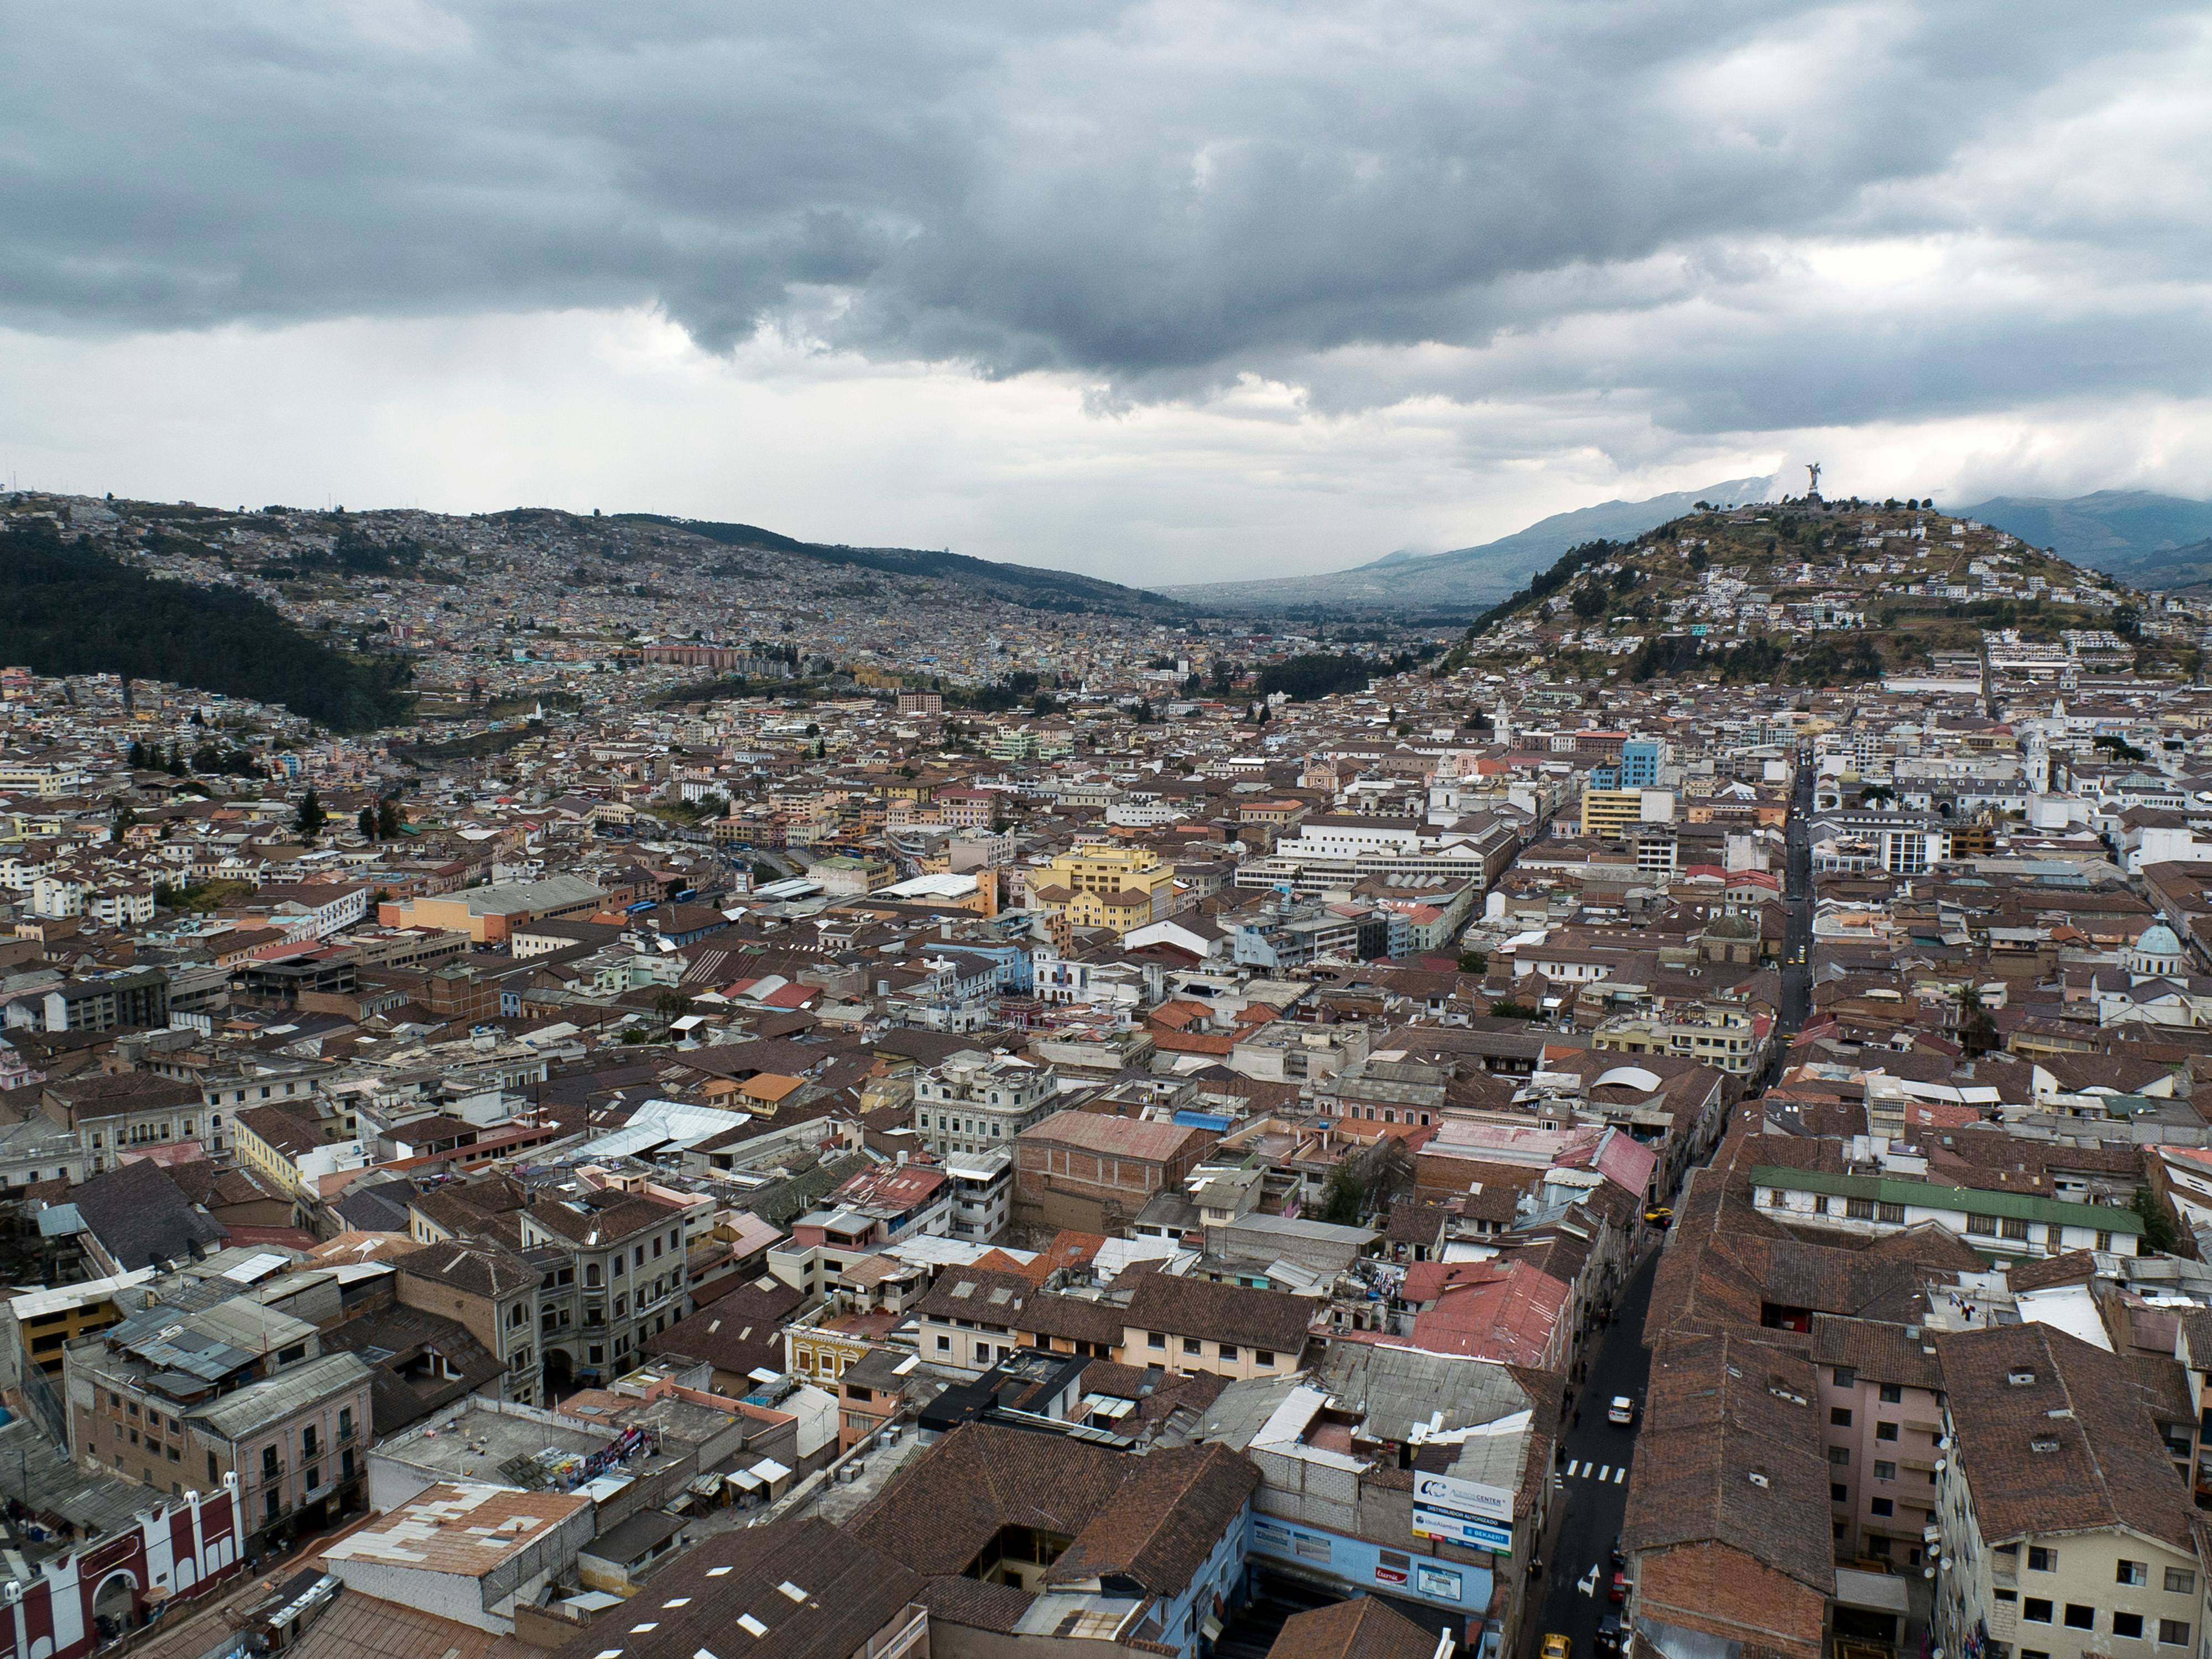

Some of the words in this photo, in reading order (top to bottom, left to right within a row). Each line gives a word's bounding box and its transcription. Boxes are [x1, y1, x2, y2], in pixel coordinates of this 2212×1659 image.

[1427, 1505, 1463, 1517] DISTRIBUIDOR
[1464, 1514, 1498, 1526] AUTORIZADO
[1474, 1530, 1504, 1541] BEKAERT
